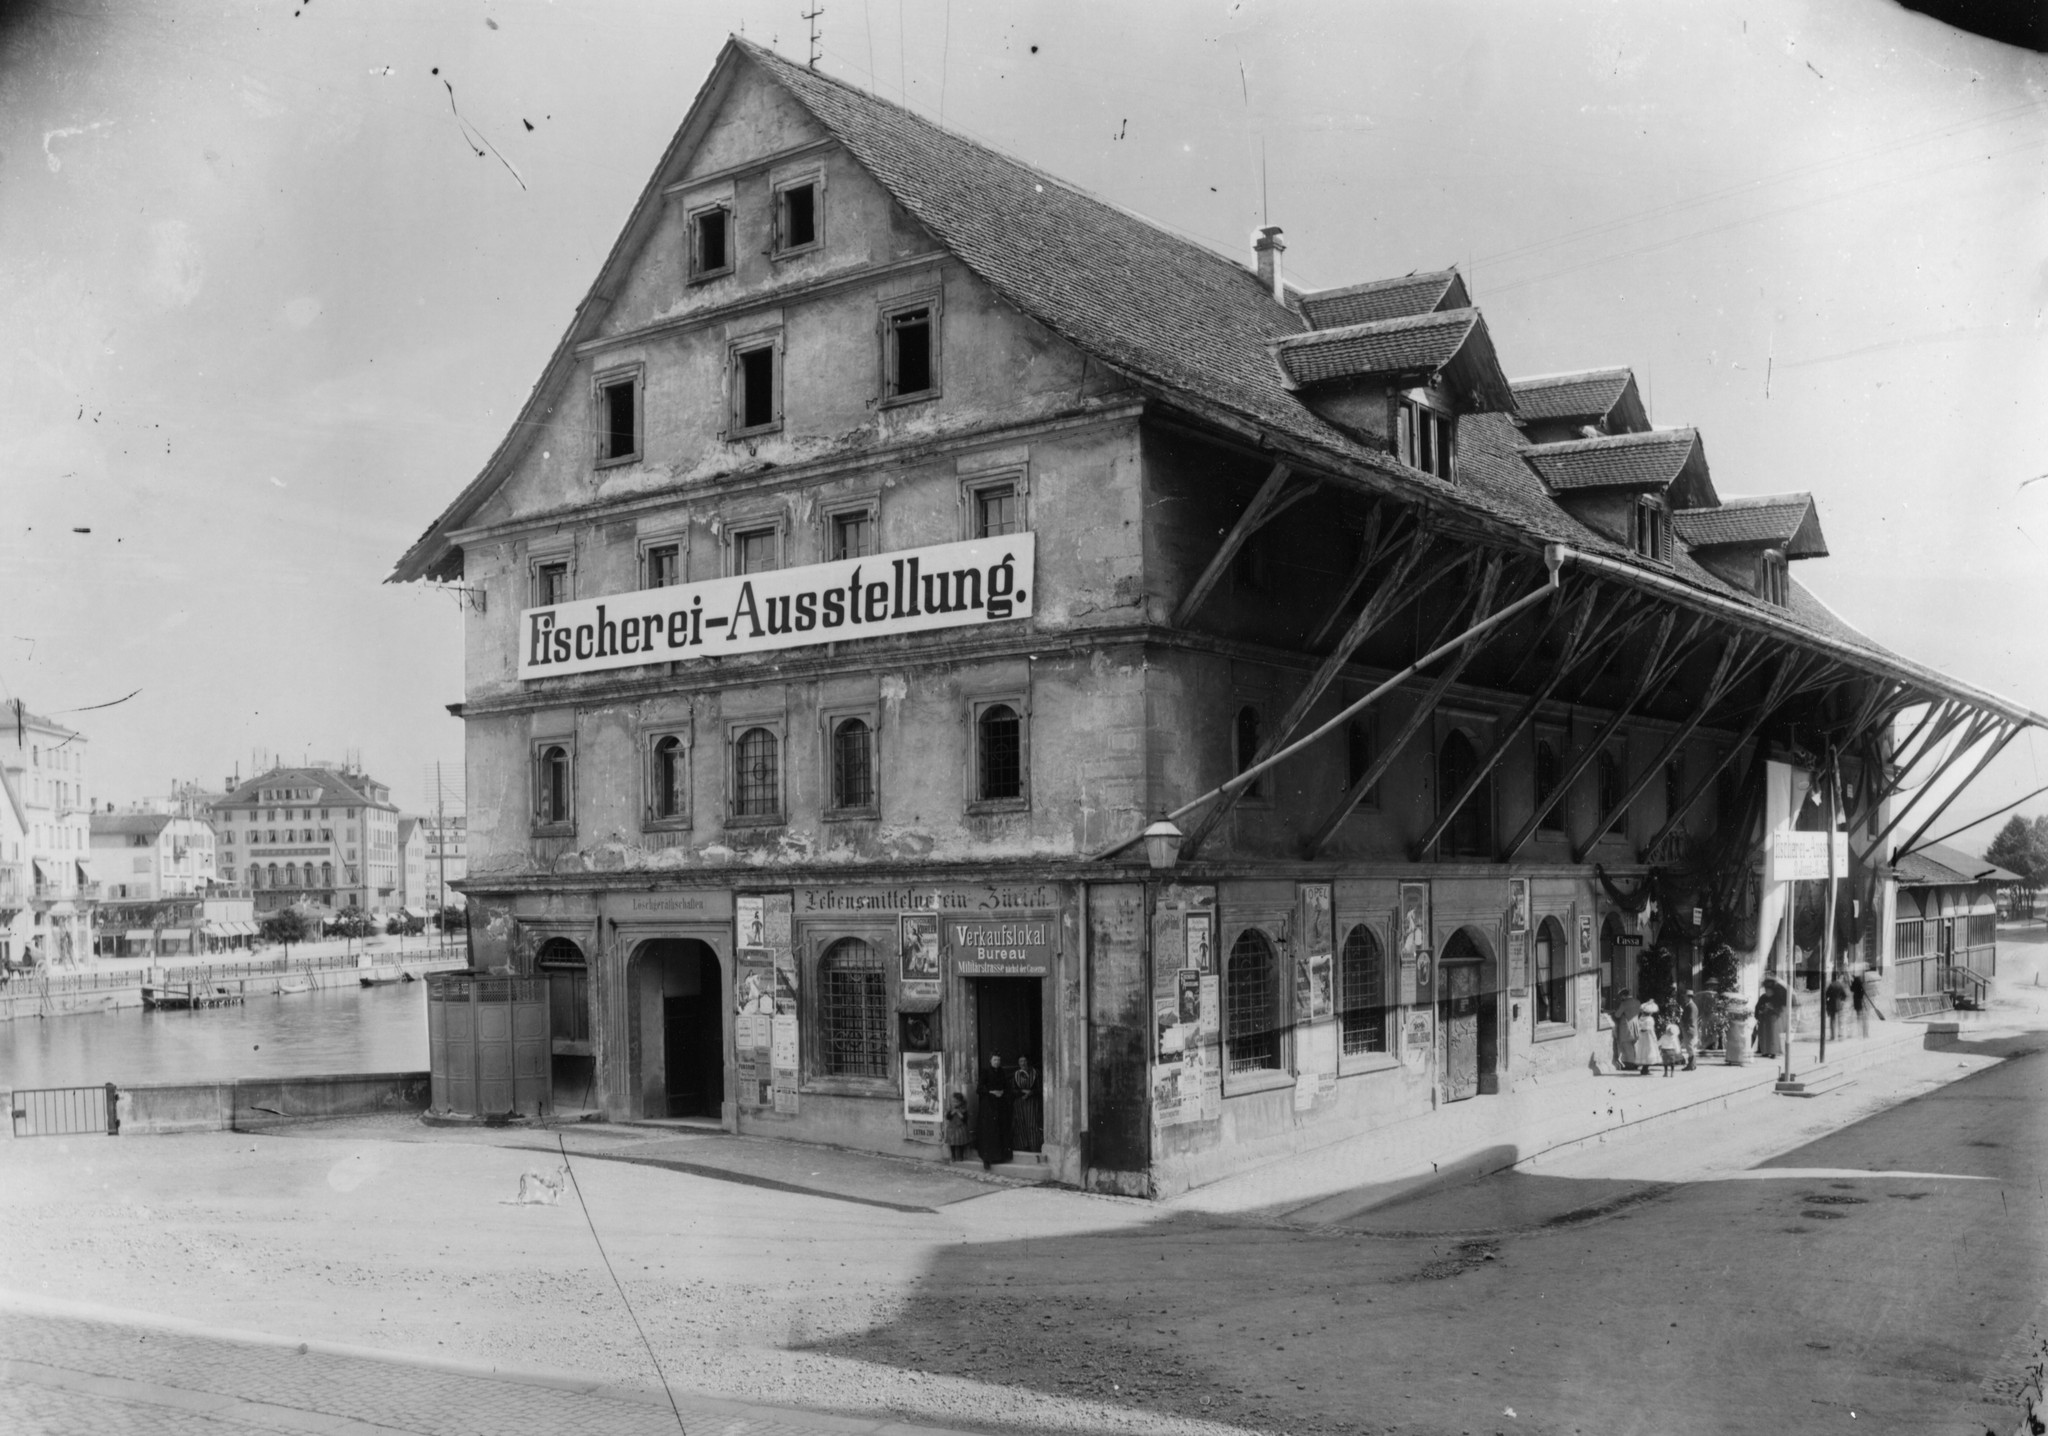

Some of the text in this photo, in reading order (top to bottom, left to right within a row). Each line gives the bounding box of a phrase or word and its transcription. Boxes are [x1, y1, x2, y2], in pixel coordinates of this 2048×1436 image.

[527, 552, 1027, 666] Fischerei-Ausstellung.
[1307, 886, 1328, 900] OPEL
[956, 924, 1046, 947] Verkaufslokal
[1616, 935, 1640, 946] Cassa
[977, 947, 1027, 960] Bureau
[958, 959, 1005, 973] Militärstrasse
